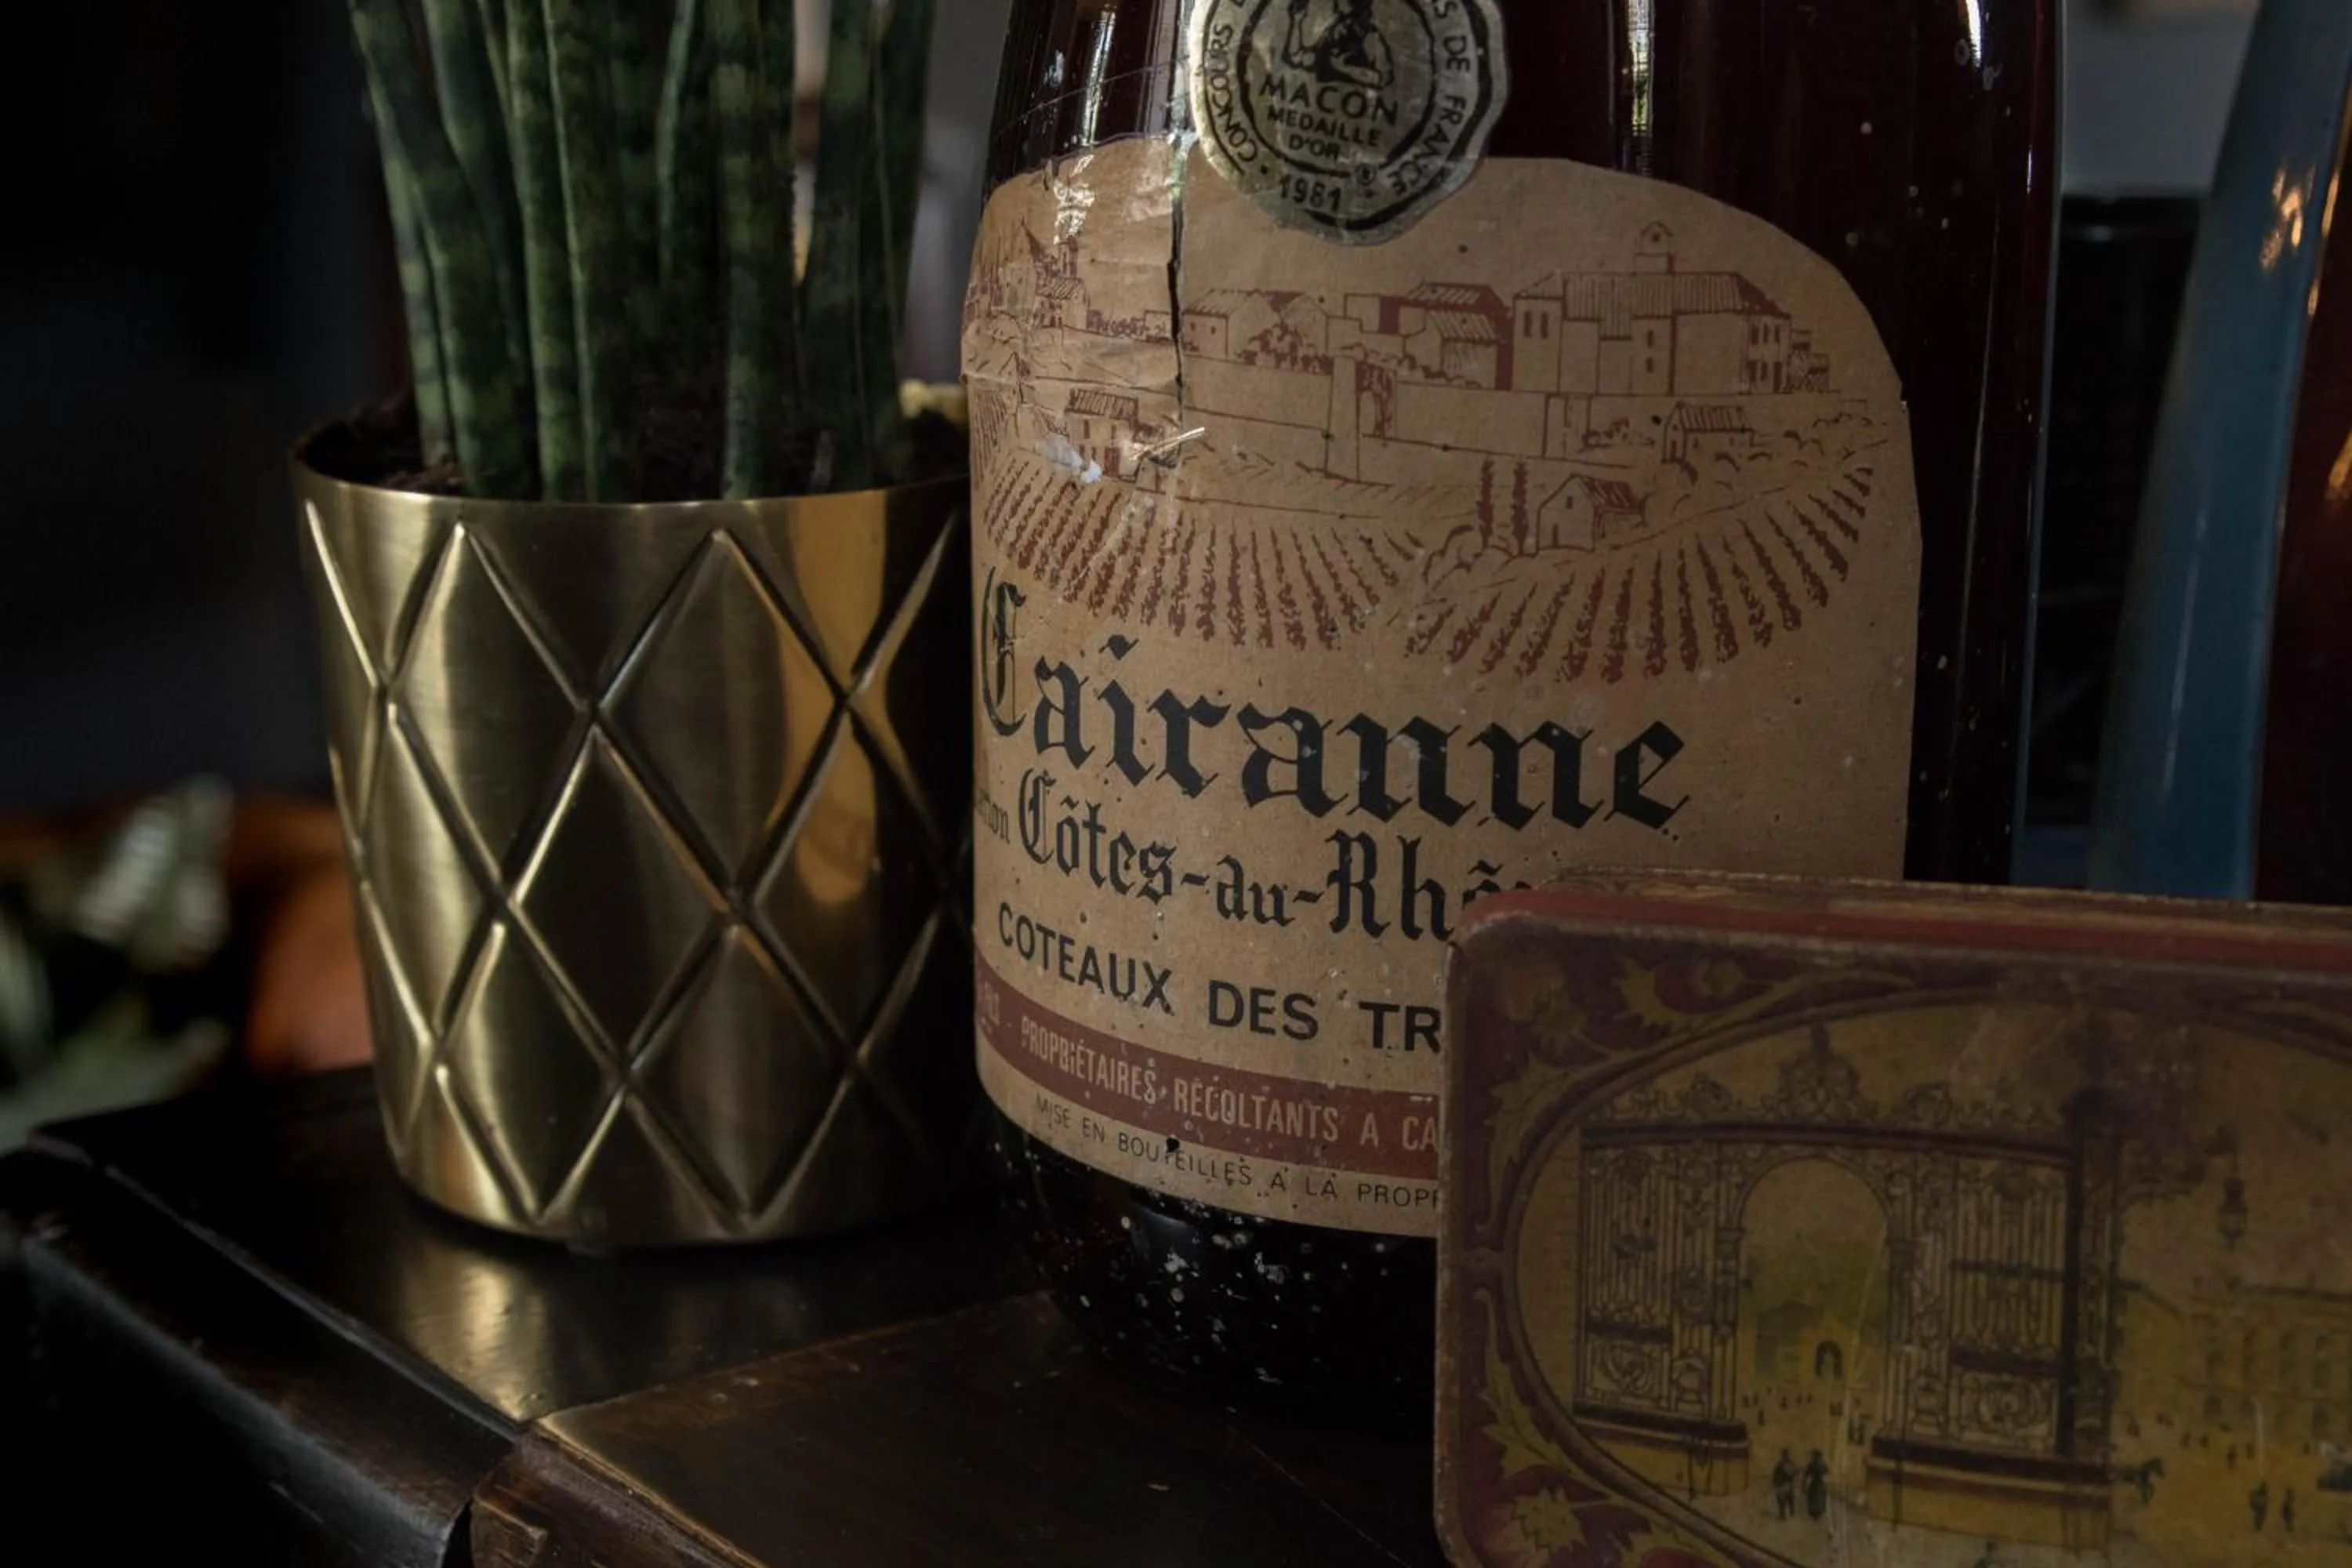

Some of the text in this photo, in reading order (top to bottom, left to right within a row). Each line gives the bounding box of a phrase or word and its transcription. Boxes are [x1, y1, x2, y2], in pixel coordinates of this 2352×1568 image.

[1210, 24, 1258, 162] CONCOURS
[1260, 74, 1398, 125] MACON
[1444, 35, 1470, 72] DE
[1267, 105, 1381, 147] MEDAILLE
[1387, 95, 1466, 194] FRANCE
[981, 566, 1690, 831] Cairanne
[999, 902, 1175, 1016] COTEAUX
[1208, 979, 1319, 1040] DES
[1036, 1094, 1071, 1129] MISE
[1083, 1117, 1105, 1142] EN
[1305, 1176, 1338, 1199] LA
[1360, 1112, 1378, 1147] A
